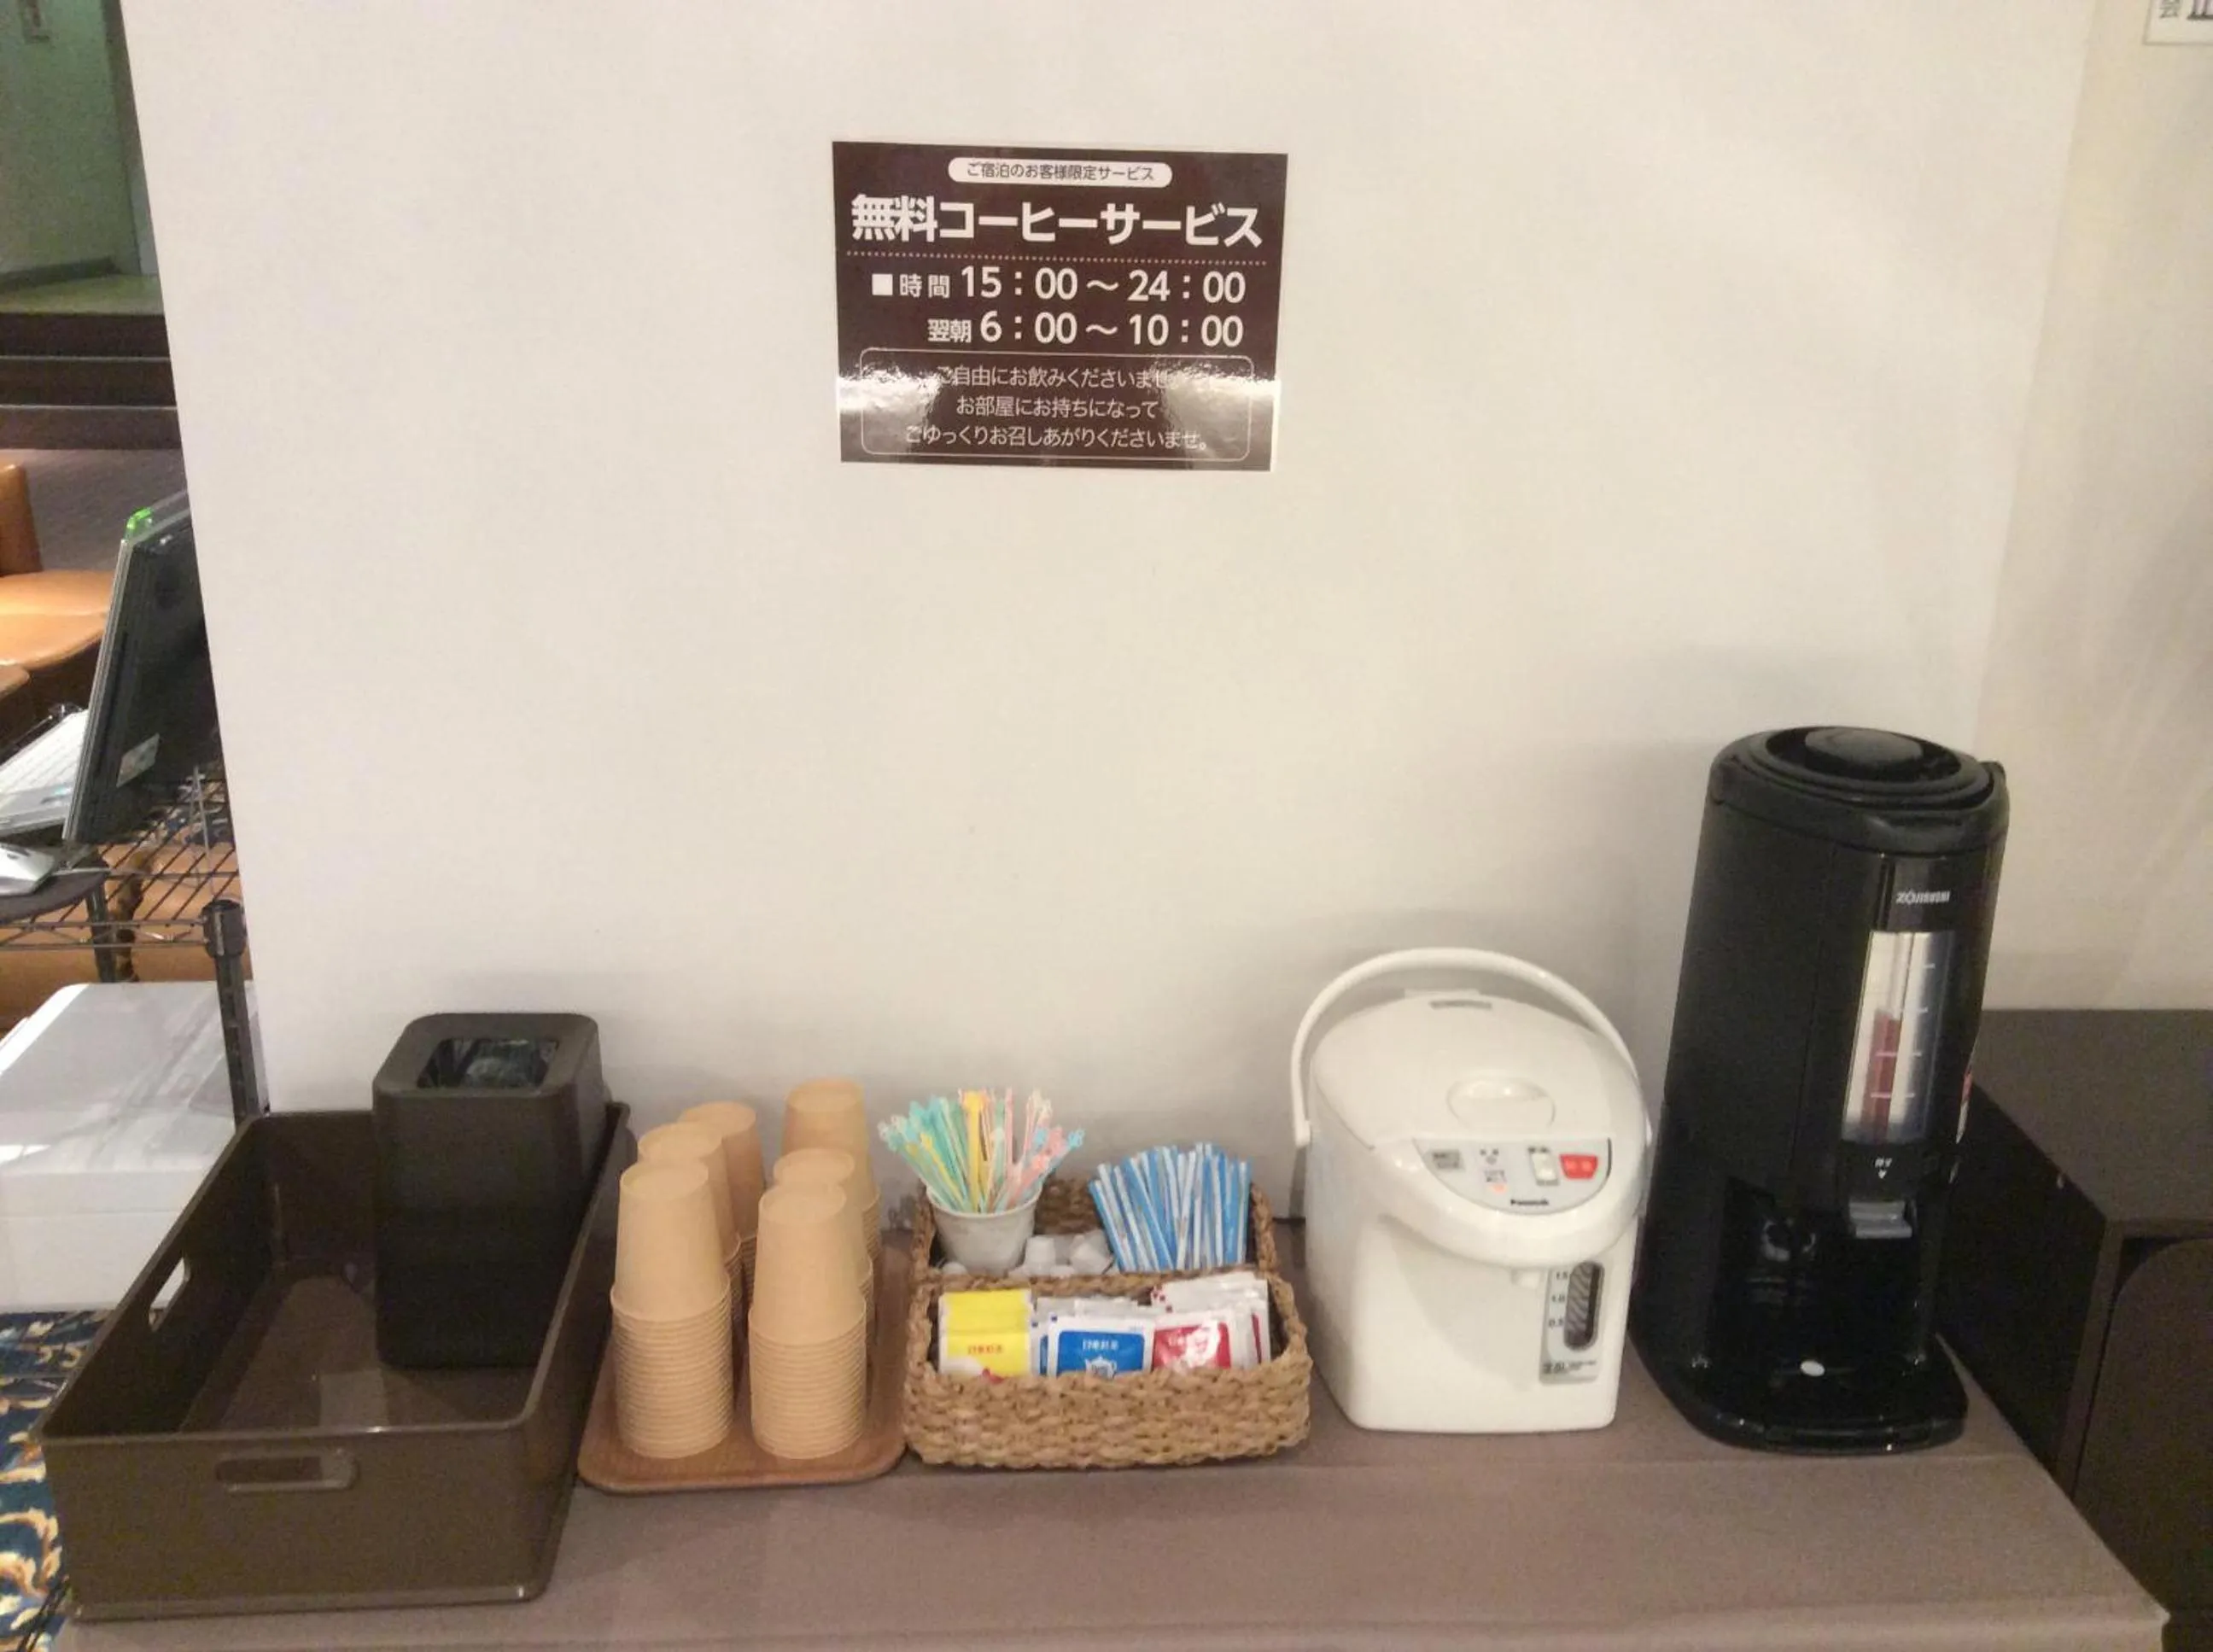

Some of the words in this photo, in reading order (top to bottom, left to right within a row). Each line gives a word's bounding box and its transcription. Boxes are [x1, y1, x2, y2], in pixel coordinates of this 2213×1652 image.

[966, 161, 1155, 182] ご宿泊のお客様限定サービス
[851, 193, 1263, 248] 無料コーヒーサービス
[956, 394, 1159, 419] お部屋にお持ちになって
[906, 425, 1207, 451] ごゆっくりお召しあがりくださいませ。
